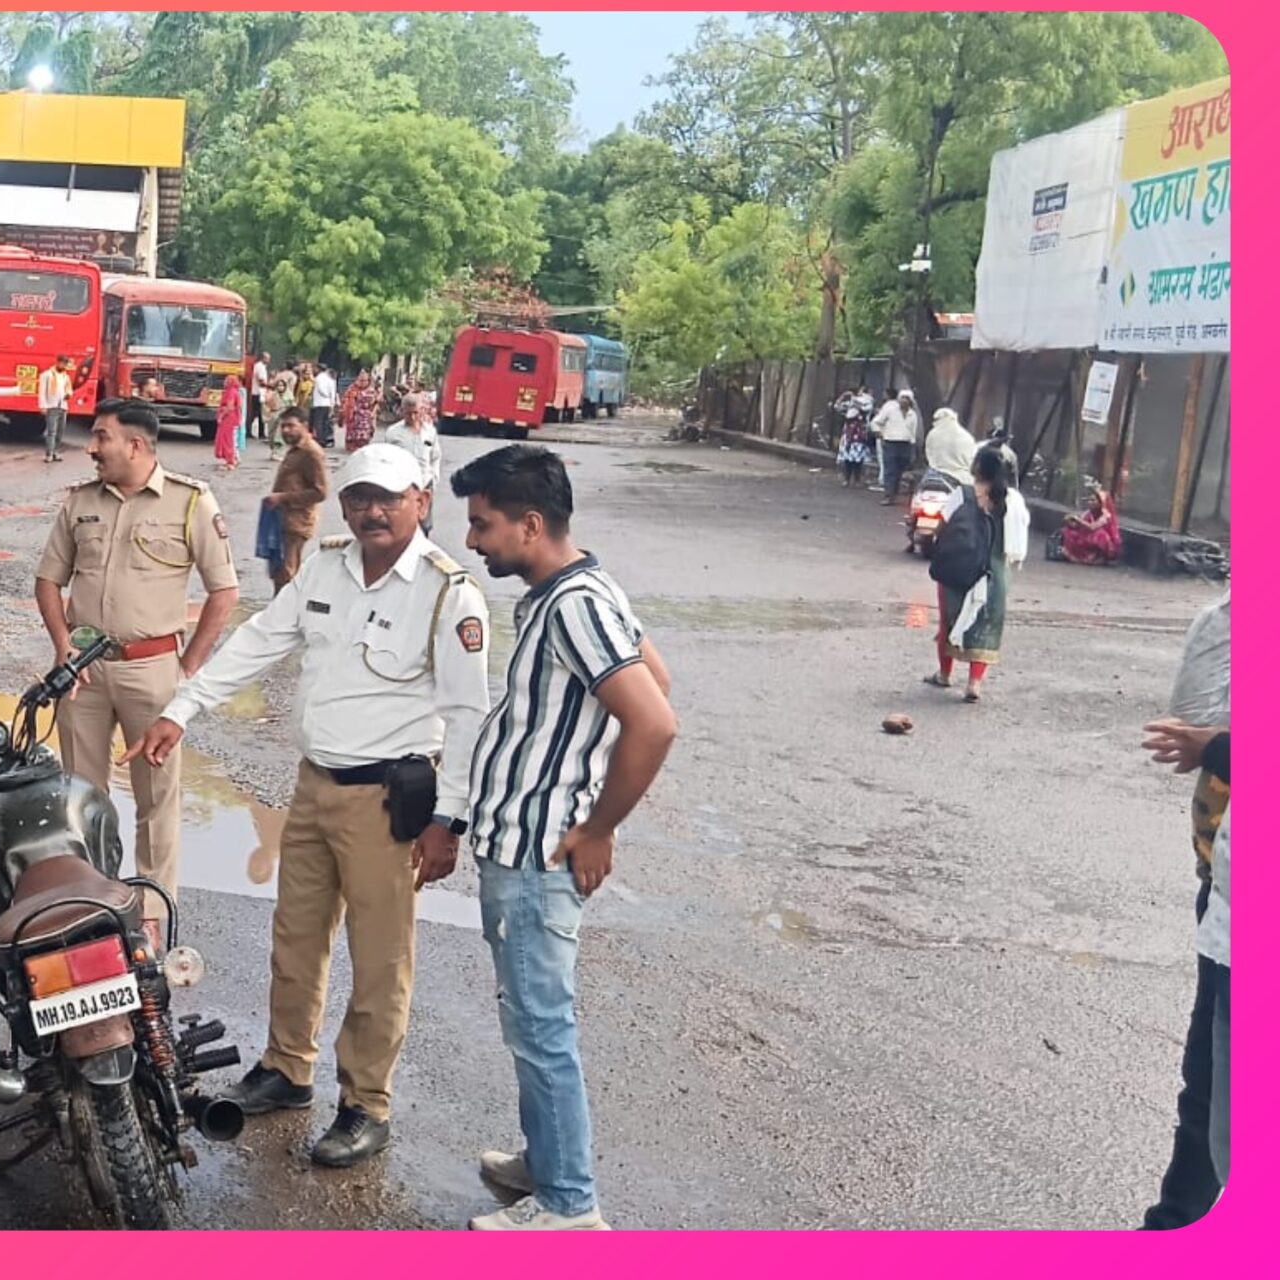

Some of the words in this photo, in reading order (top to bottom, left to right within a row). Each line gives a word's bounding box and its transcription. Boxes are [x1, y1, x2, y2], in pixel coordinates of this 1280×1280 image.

[1130, 167, 1198, 229] खमण
[1202, 160, 1231, 225] हा
[36, 986, 136, 1029] MH.19.AJ.9923
